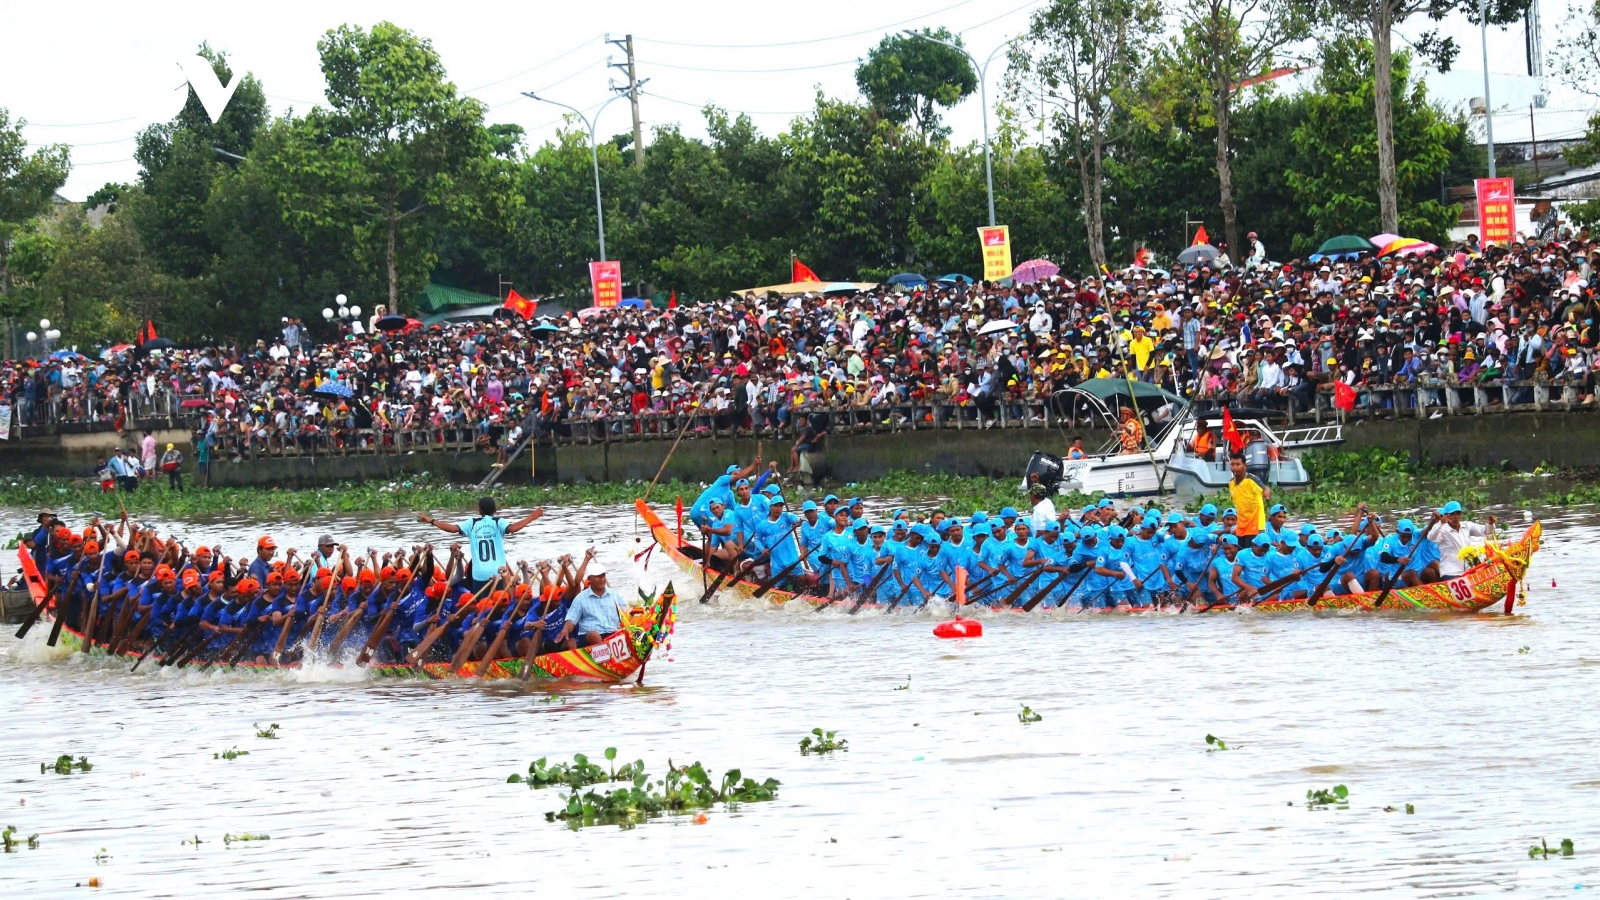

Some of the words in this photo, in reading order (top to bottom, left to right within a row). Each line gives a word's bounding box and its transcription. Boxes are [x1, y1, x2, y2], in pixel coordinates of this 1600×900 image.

[479, 539, 496, 562] 01
[1450, 579, 1472, 601] 36
[612, 639, 626, 659] 02
